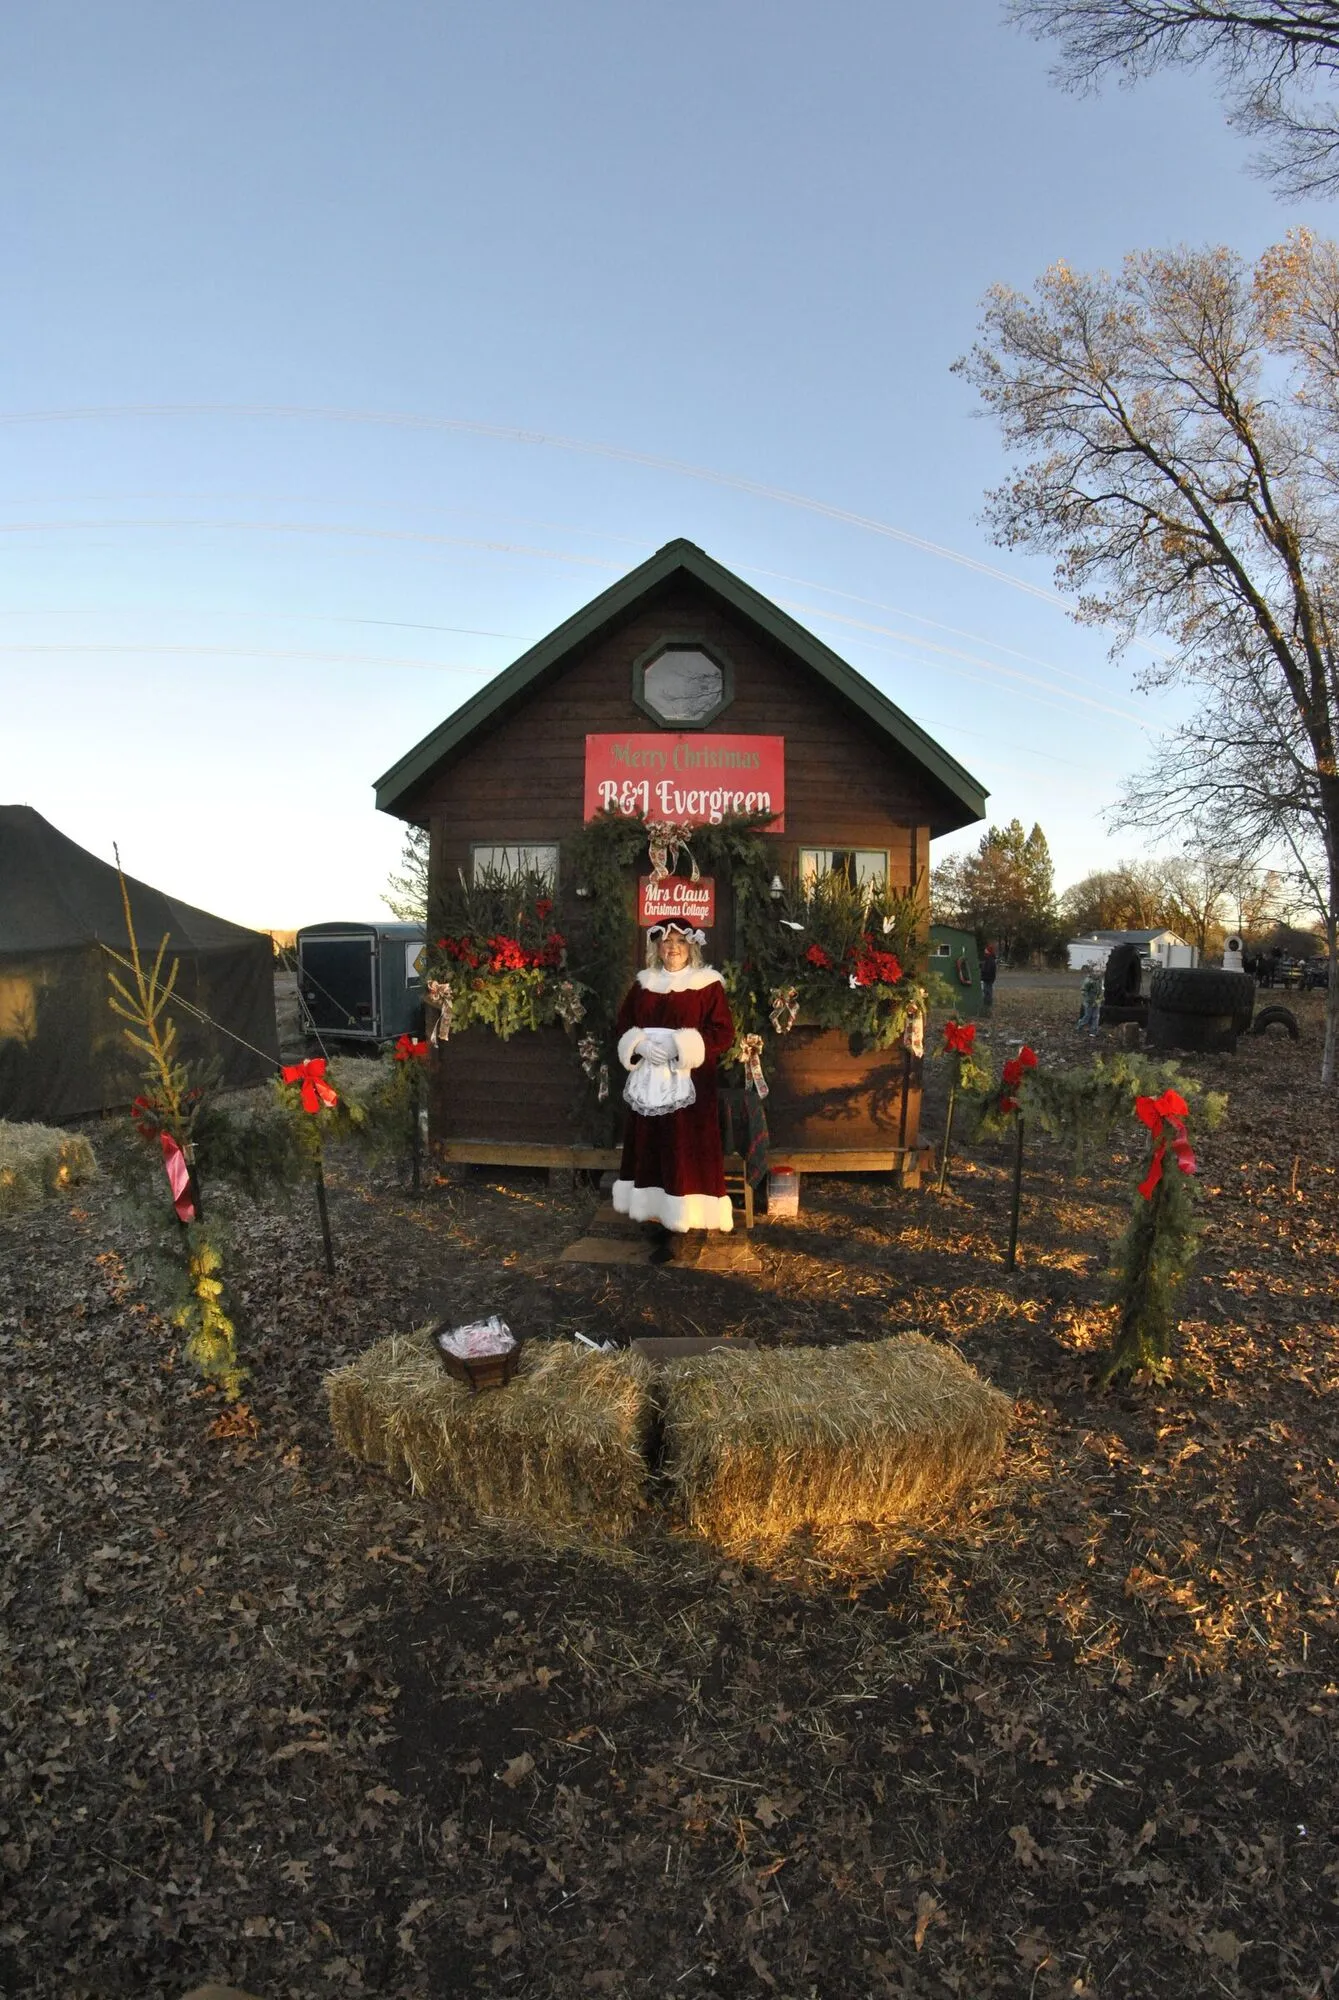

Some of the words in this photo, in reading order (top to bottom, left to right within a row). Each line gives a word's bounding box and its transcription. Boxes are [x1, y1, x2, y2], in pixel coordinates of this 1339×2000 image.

[609, 740, 668, 774] Merry
[672, 743, 760, 771] Christmas
[655, 780, 771, 825] Evergreen
[645, 884, 671, 901] Mrs
[673, 884, 710, 902] Claus
[644, 901, 681, 916] Christmas
[682, 902, 709, 920] Cottage
